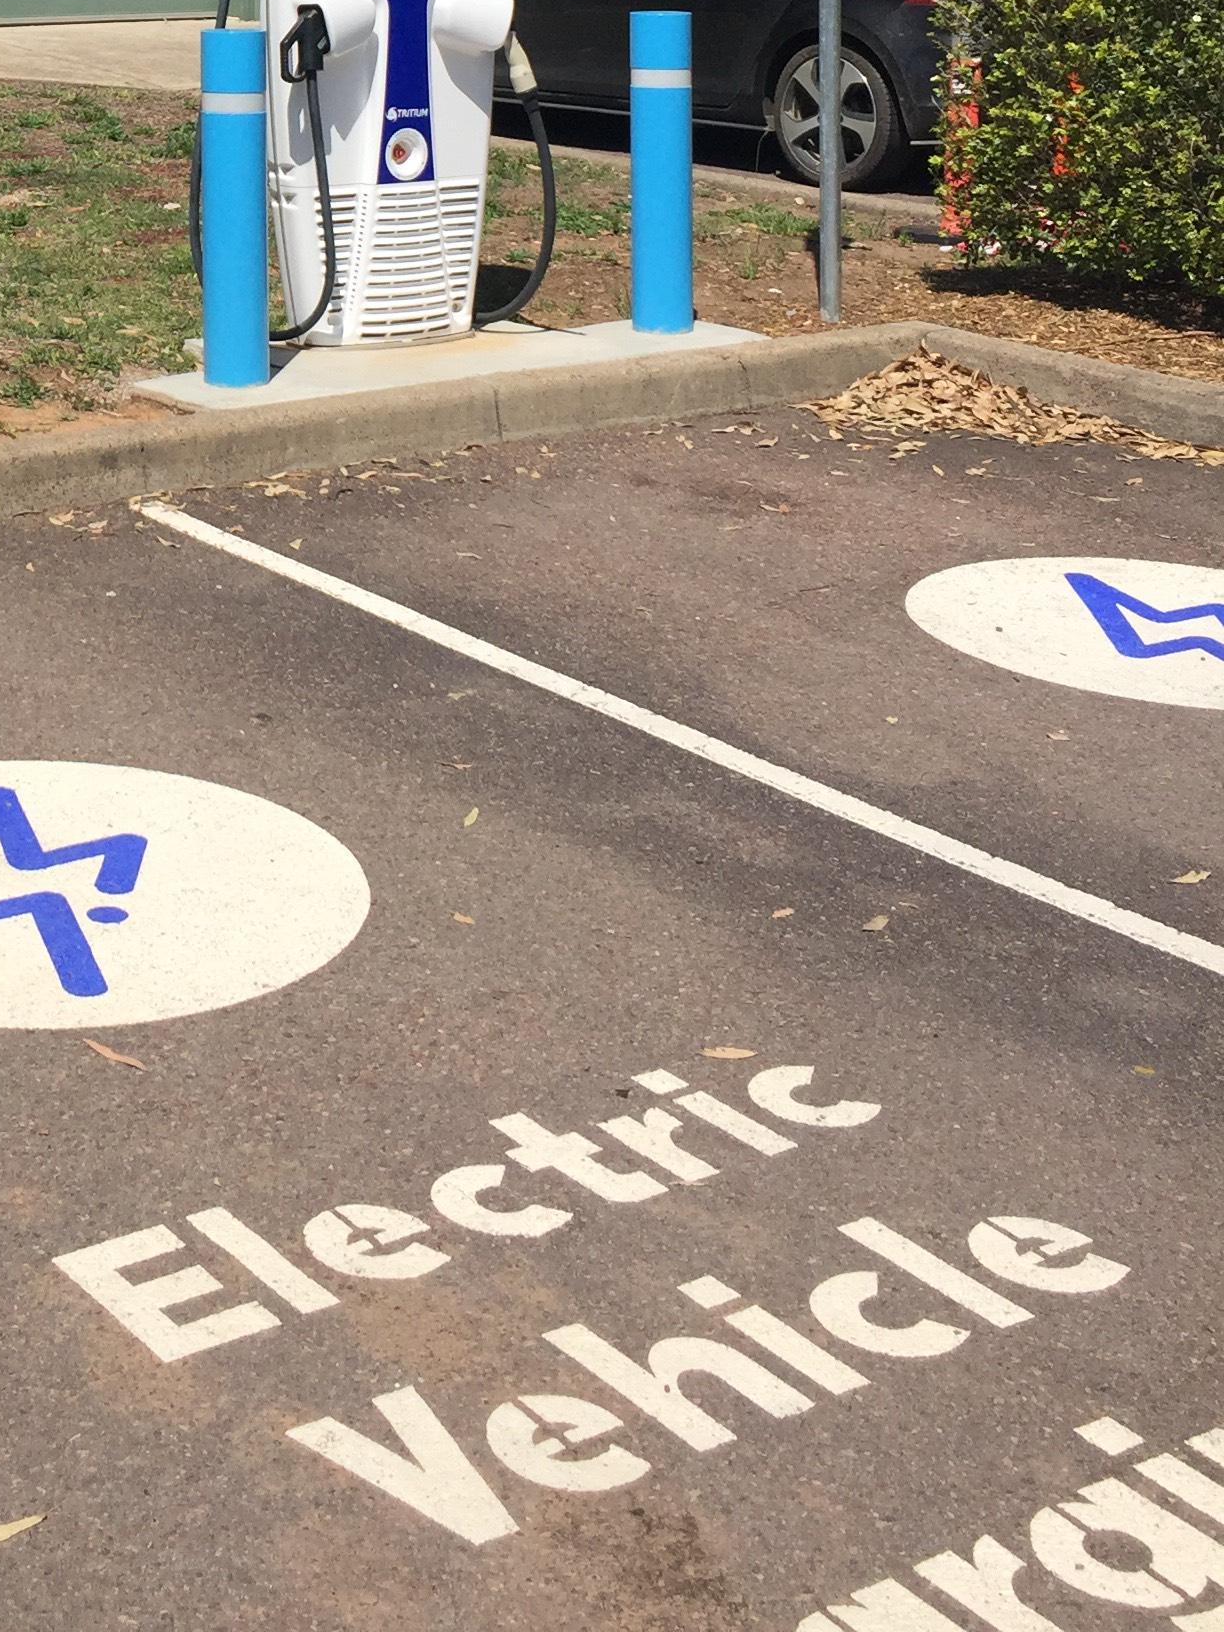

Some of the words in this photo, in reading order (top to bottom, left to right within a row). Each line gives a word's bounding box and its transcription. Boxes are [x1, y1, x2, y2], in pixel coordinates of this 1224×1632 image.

[397, 109, 428, 118] TRITIUM
[51, 1064, 881, 1363] Electric
[284, 1216, 1132, 1546] Vehicle
